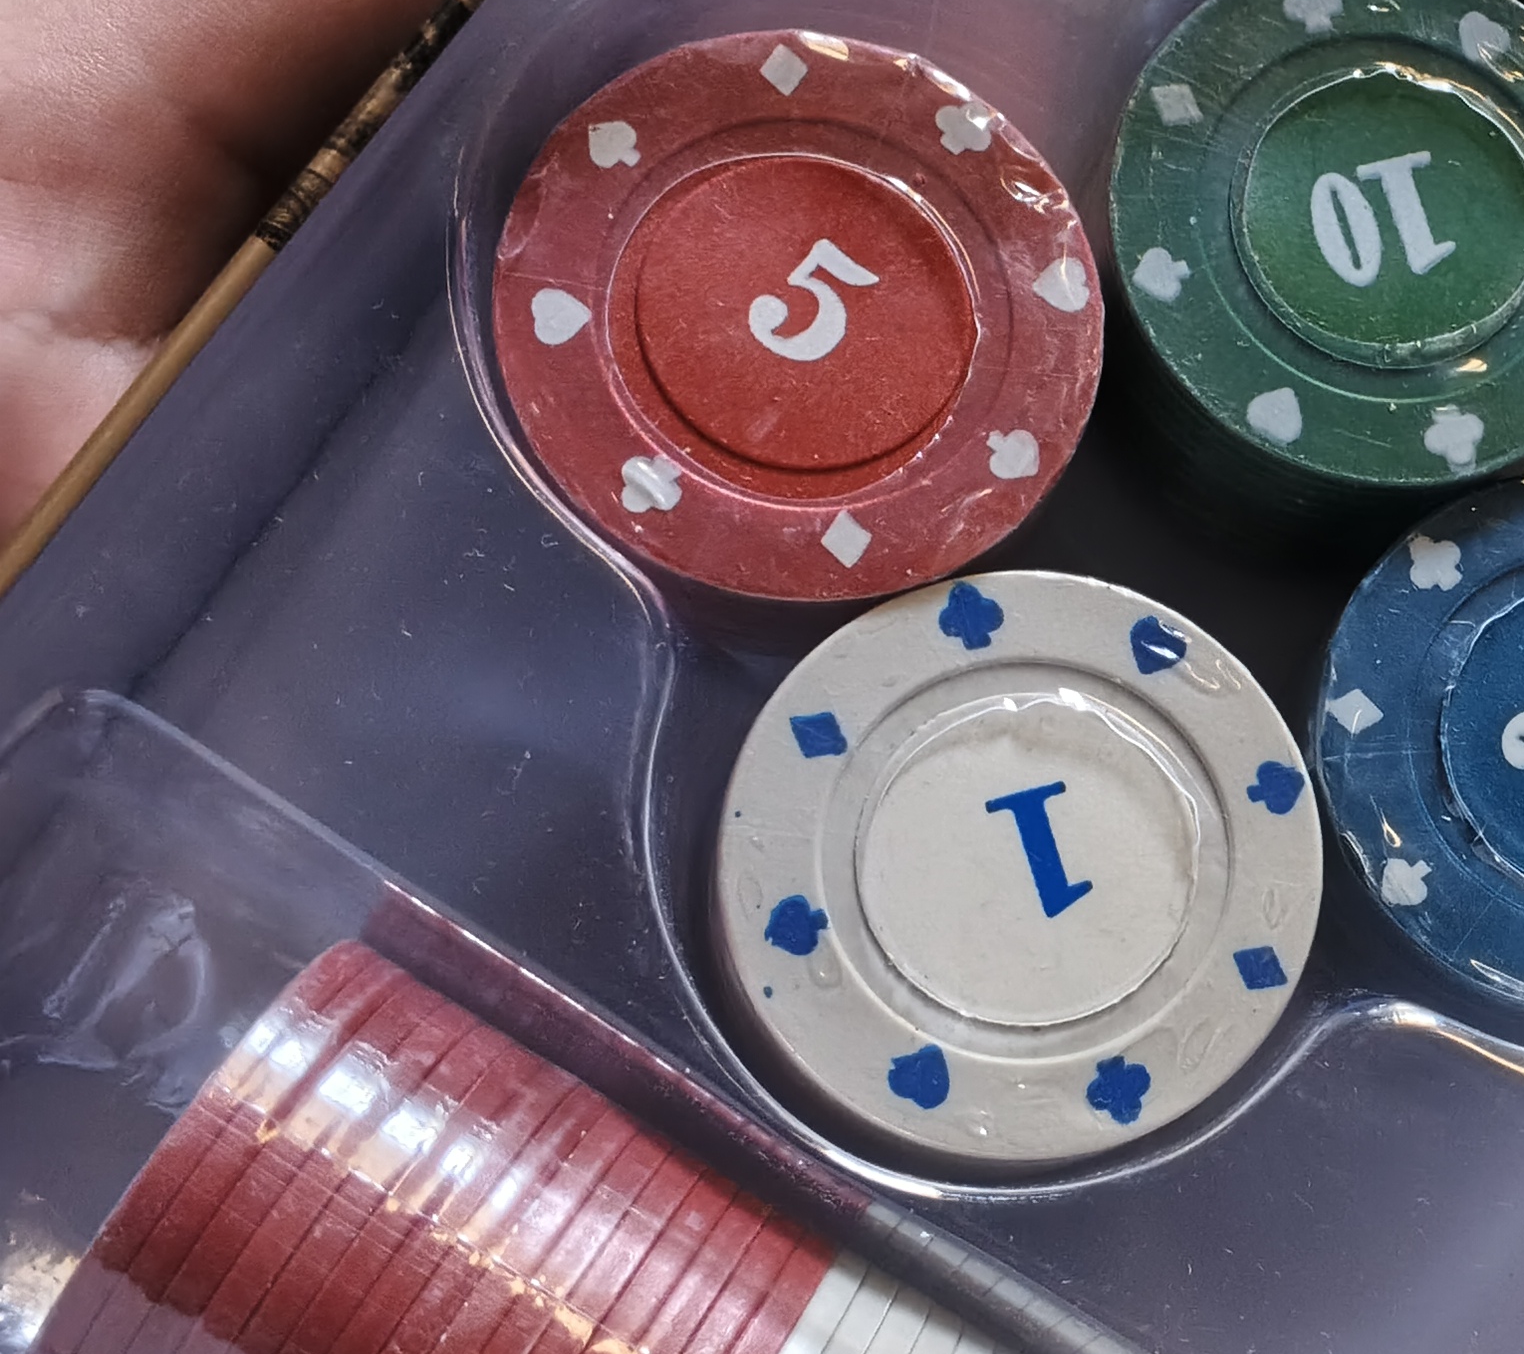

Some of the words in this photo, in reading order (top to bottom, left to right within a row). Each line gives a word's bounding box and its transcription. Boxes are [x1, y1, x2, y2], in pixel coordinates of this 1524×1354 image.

[1309, 149, 1460, 290] 10
[746, 237, 881, 361] 5
[984, 779, 1094, 918] 1
